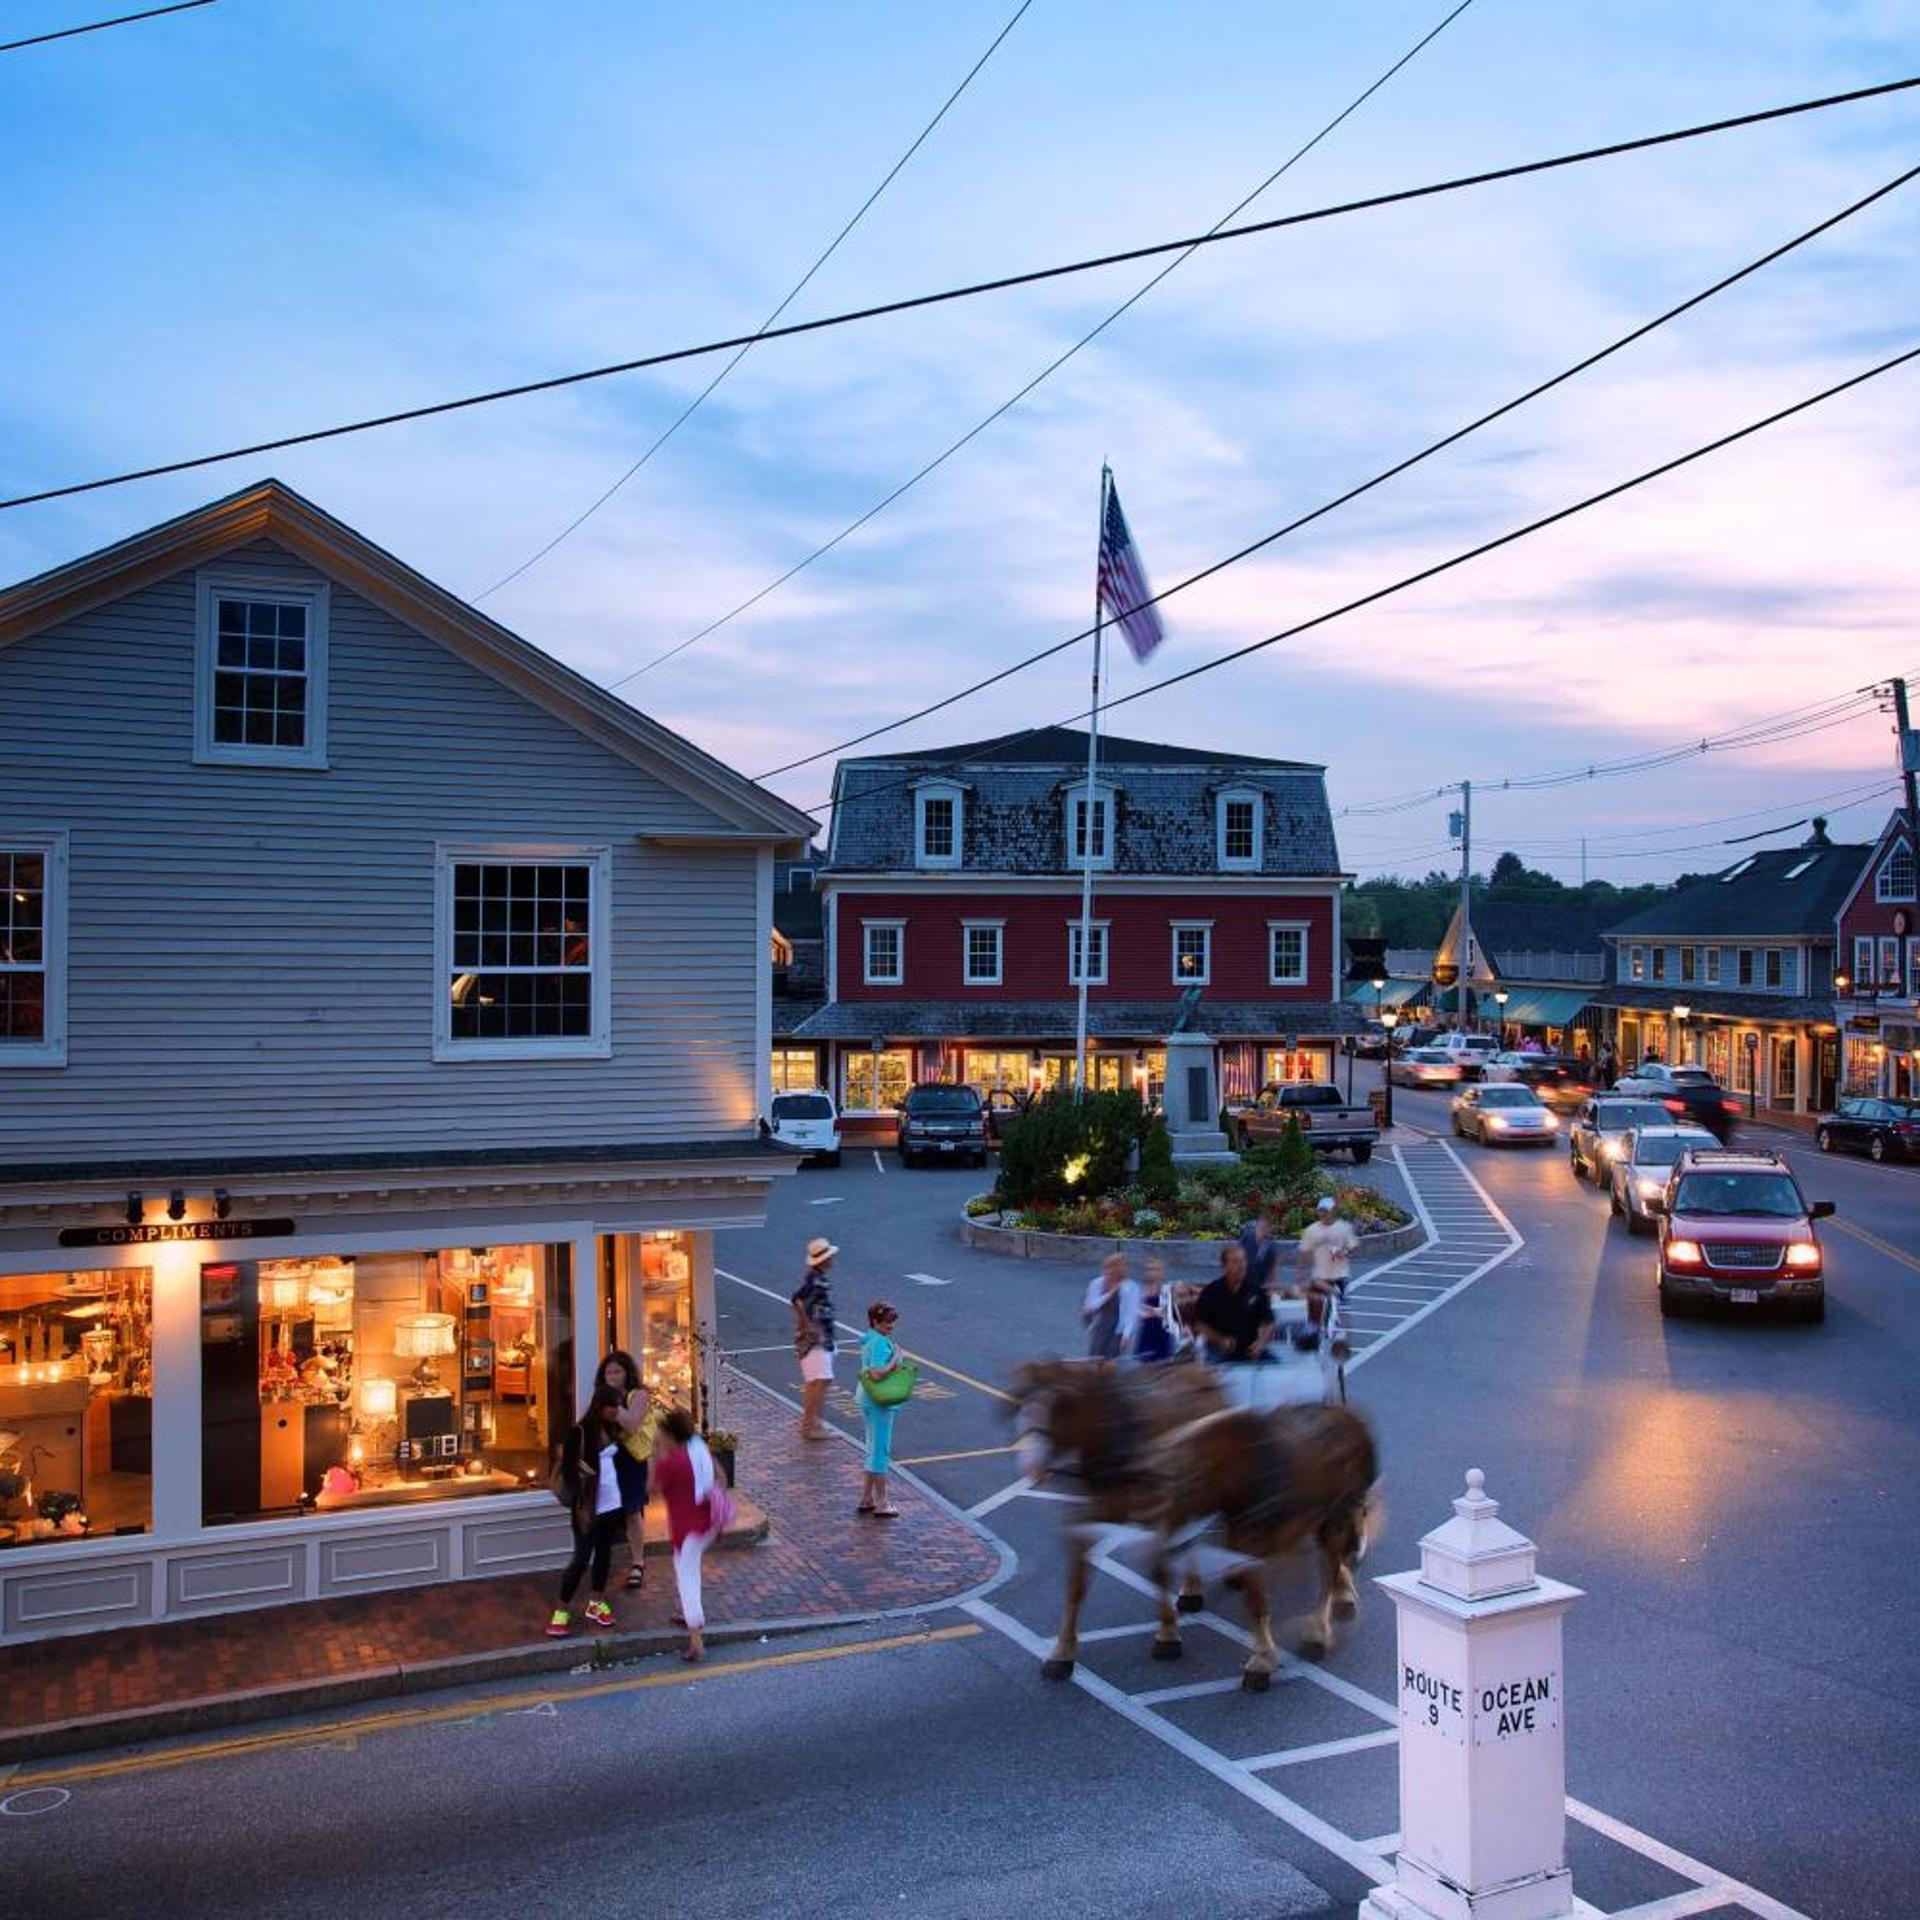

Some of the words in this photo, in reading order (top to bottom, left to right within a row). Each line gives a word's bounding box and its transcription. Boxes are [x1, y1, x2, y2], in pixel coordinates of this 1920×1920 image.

[96, 1222, 254, 1243] COMPLIMENTS
[1404, 1667, 1463, 1713] ROUTE
[1482, 1677, 1549, 1712] OCEAN
[1428, 1704, 1439, 1726] 9
[1497, 1707, 1535, 1736] AVE
